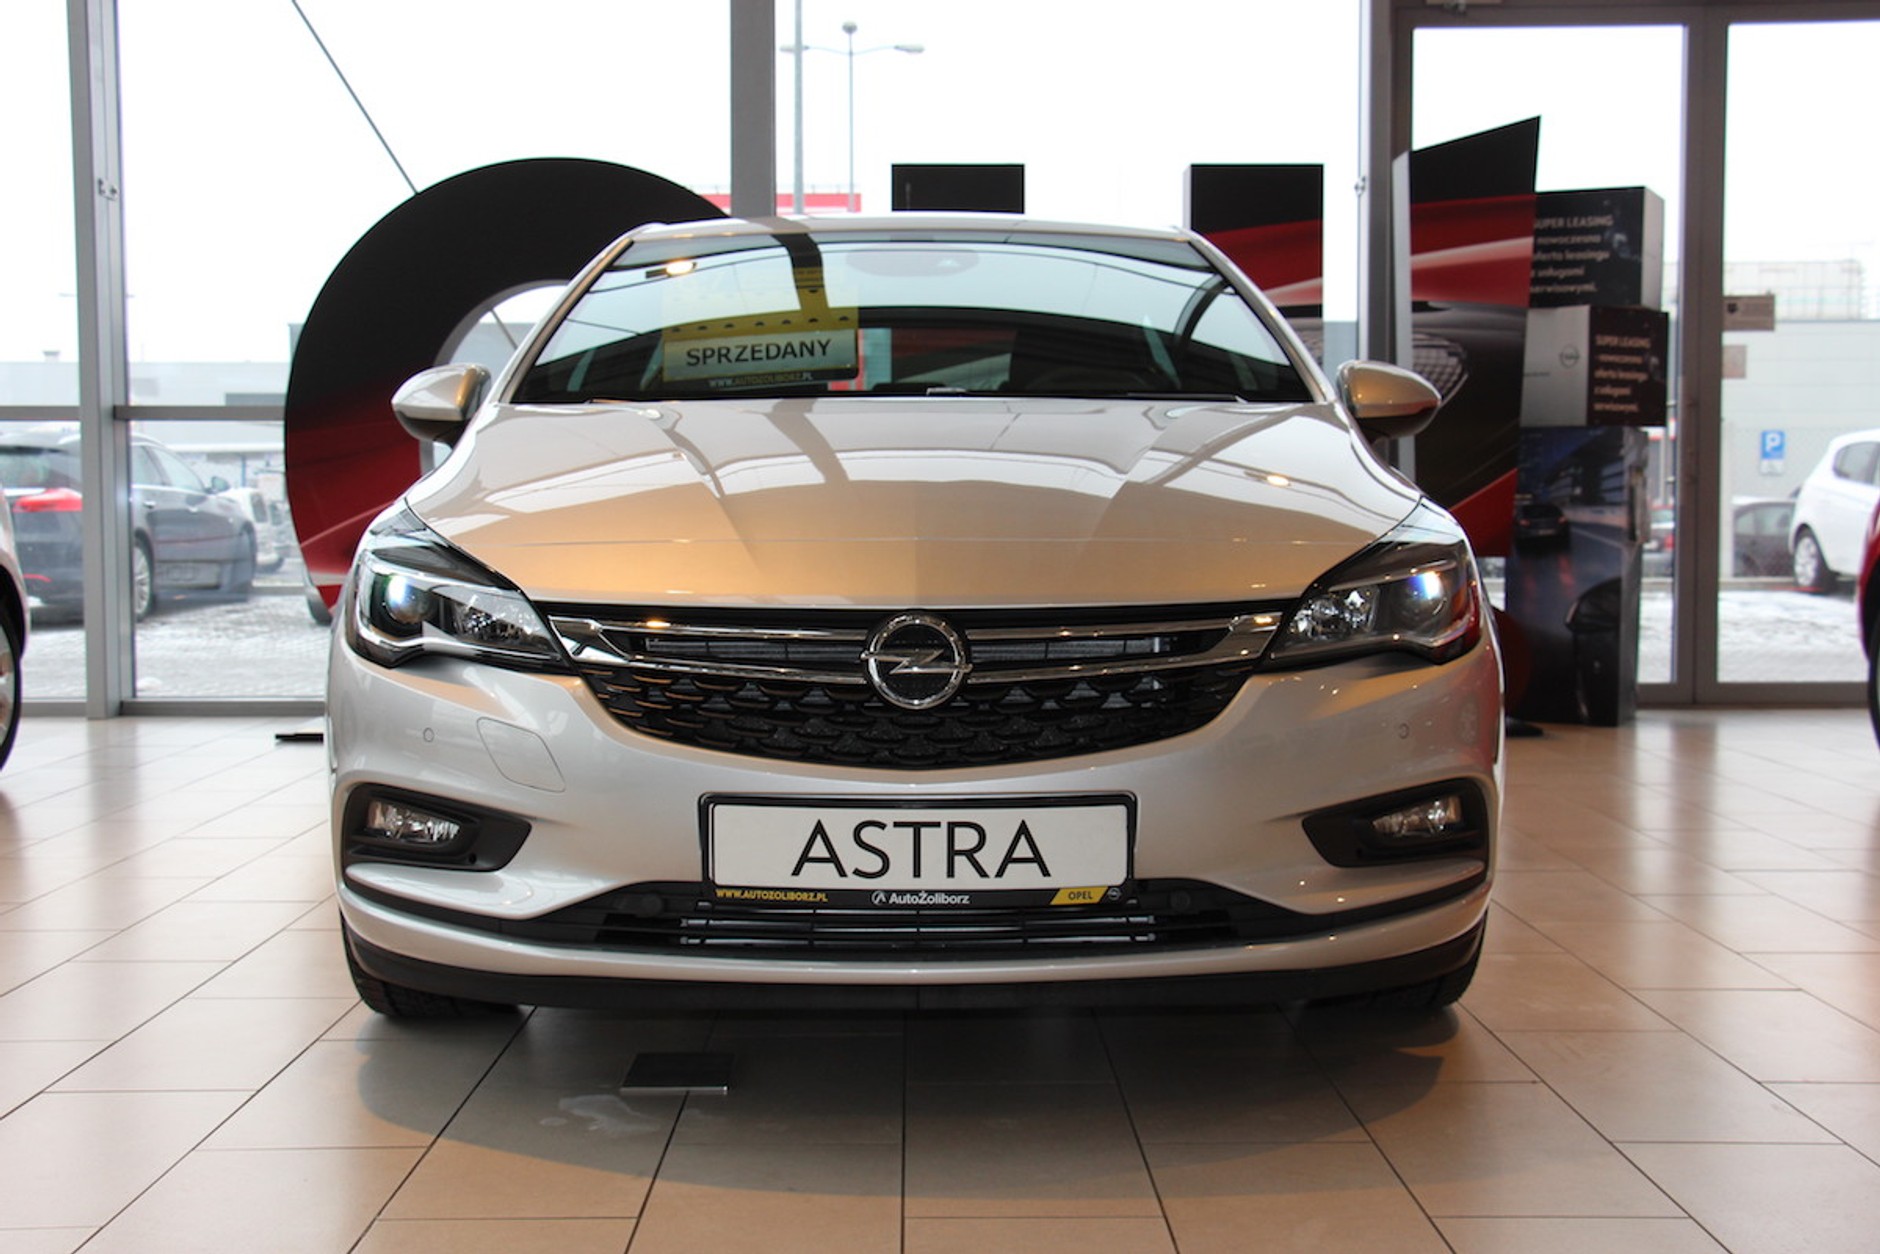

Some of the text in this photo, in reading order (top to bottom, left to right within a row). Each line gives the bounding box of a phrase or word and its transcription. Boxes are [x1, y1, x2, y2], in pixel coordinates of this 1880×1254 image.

[1567, 215, 1613, 227] LEASING
[686, 339, 831, 367] SPRZEDANY
[1765, 433, 1782, 453] P
[791, 819, 1051, 879] ASTRA
[888, 890, 970, 905] AutoŻoliborz
[1067, 890, 1093, 901] OPEL
